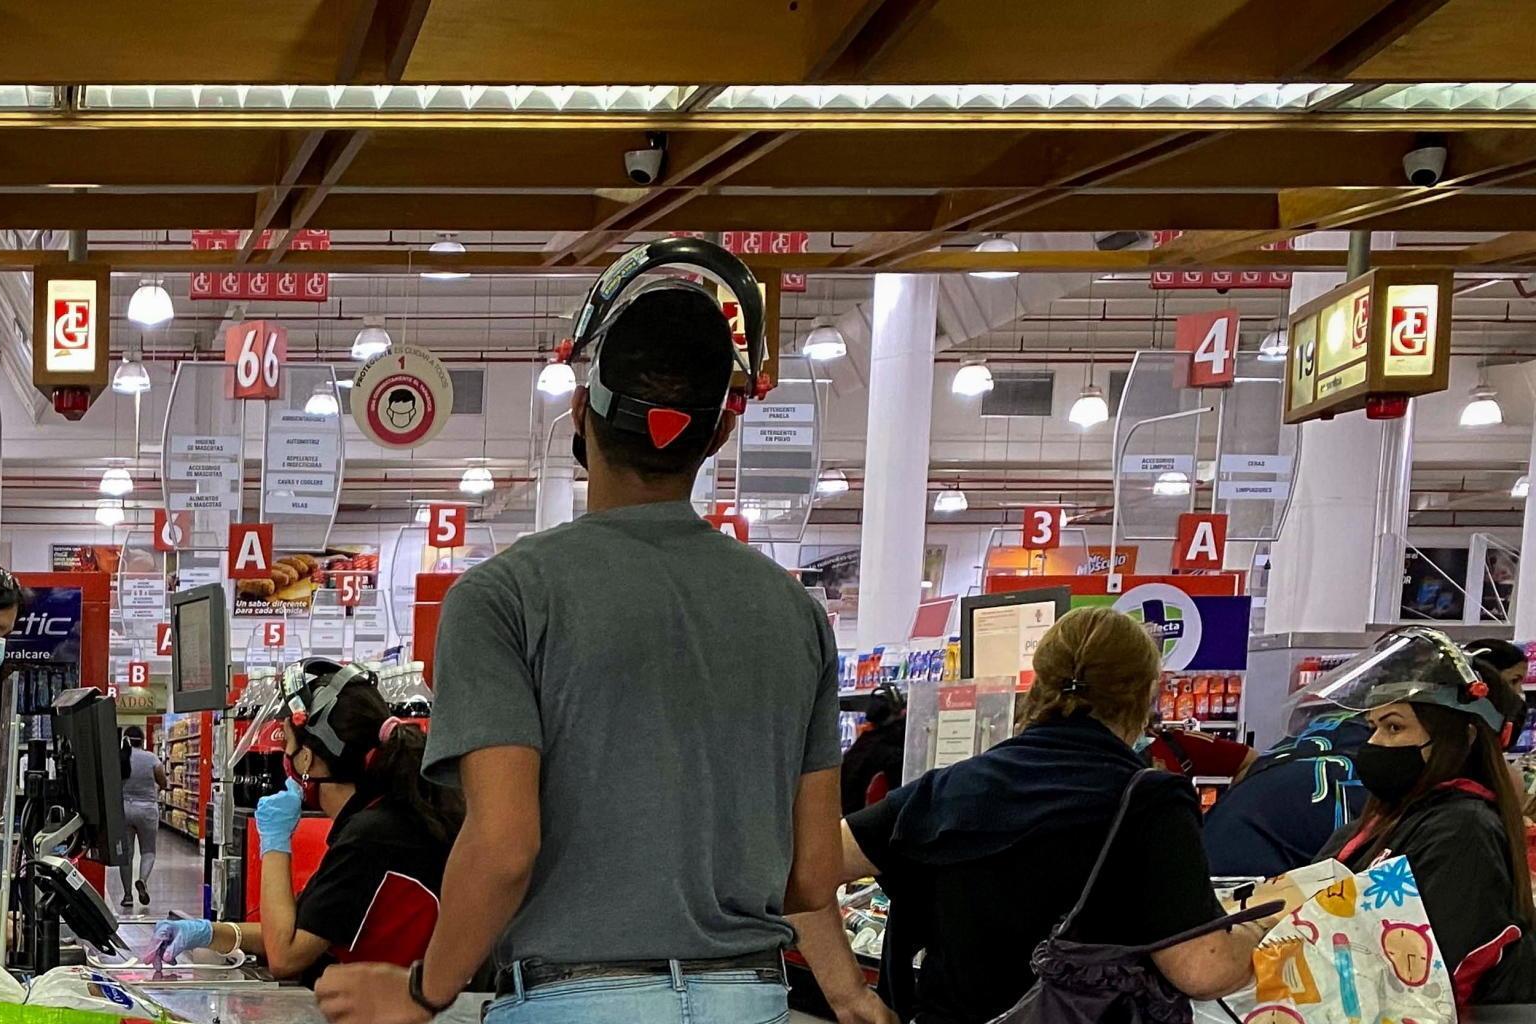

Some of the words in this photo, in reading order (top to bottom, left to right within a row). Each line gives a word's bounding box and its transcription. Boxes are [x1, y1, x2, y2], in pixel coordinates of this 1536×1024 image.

[398, 355, 405, 370] 1
[1194, 317, 1230, 375] 4
[1297, 341, 1315, 381] 19
[436, 508, 457, 541] 5
[1031, 510, 1053, 544] 3
[1185, 521, 1218, 561] A
[235, 531, 267, 570] A
[268, 624, 281, 644] 5
[132, 665, 145, 683] B
